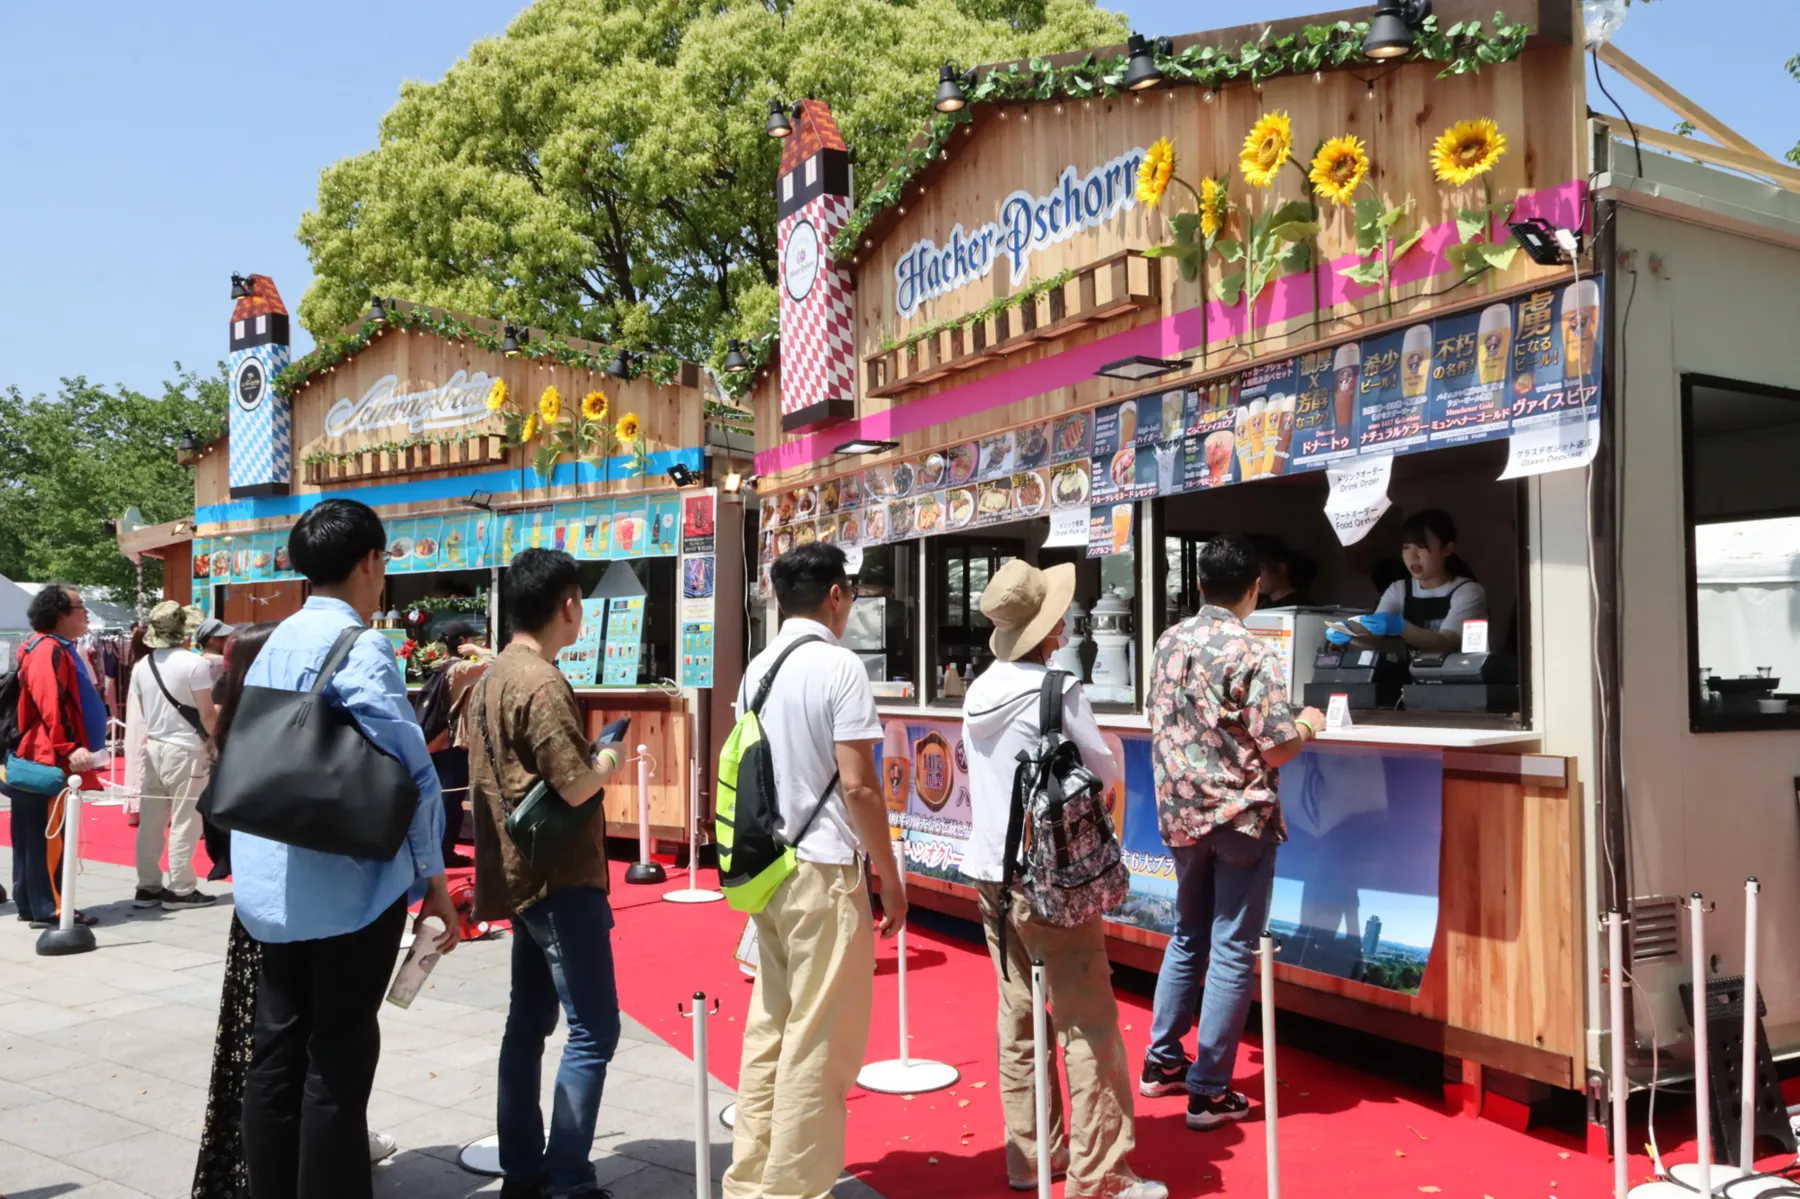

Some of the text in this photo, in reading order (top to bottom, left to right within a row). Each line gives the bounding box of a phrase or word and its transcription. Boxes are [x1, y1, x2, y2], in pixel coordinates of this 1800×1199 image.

[898, 154, 1140, 311] Hacker-Pschorr
[1435, 332, 1476, 362] 不朽
[1515, 336, 1552, 358] になる
[1363, 349, 1400, 377] 希少
